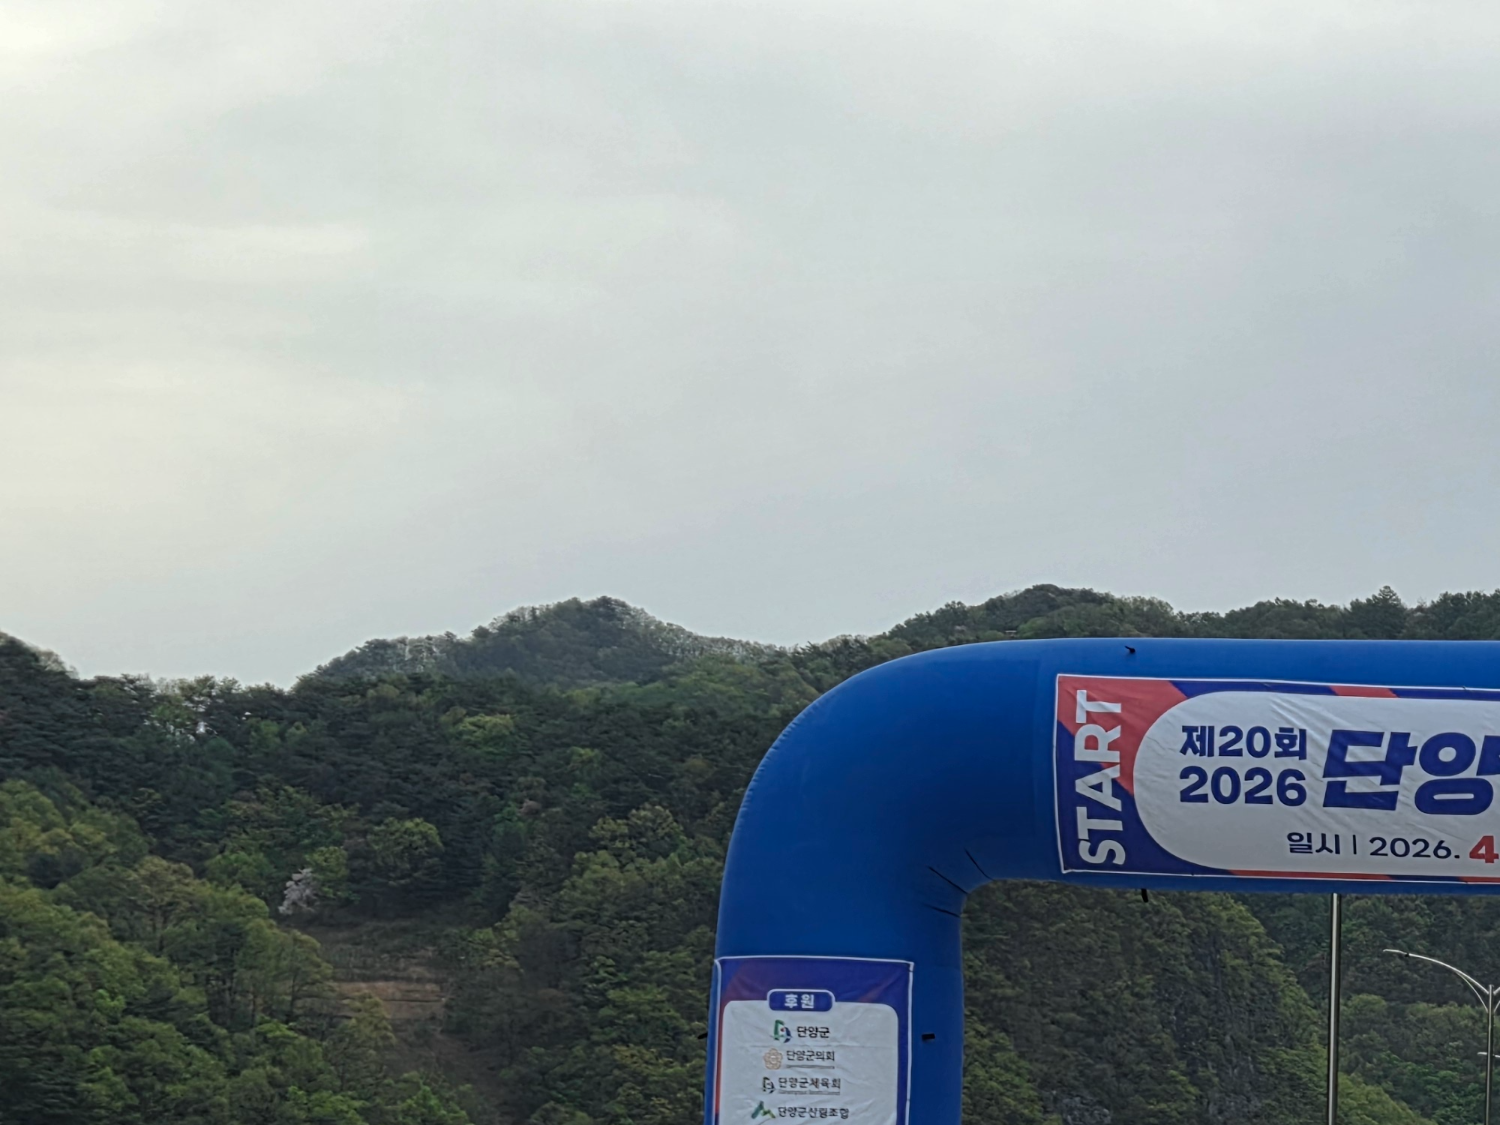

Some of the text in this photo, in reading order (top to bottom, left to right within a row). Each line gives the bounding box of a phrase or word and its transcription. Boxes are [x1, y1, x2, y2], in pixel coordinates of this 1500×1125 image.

[1179, 724, 1308, 761] 제20회
[1076, 690, 1125, 866] START
[1179, 766, 1308, 806] 2026
[1286, 832, 1341, 856] 일시
[796, 1025, 831, 1039] 단양군
[786, 1050, 835, 1061] 단양군의회
[778, 1077, 841, 1089] 단양군체육회
[777, 1106, 849, 1119] 단양군산림조합
